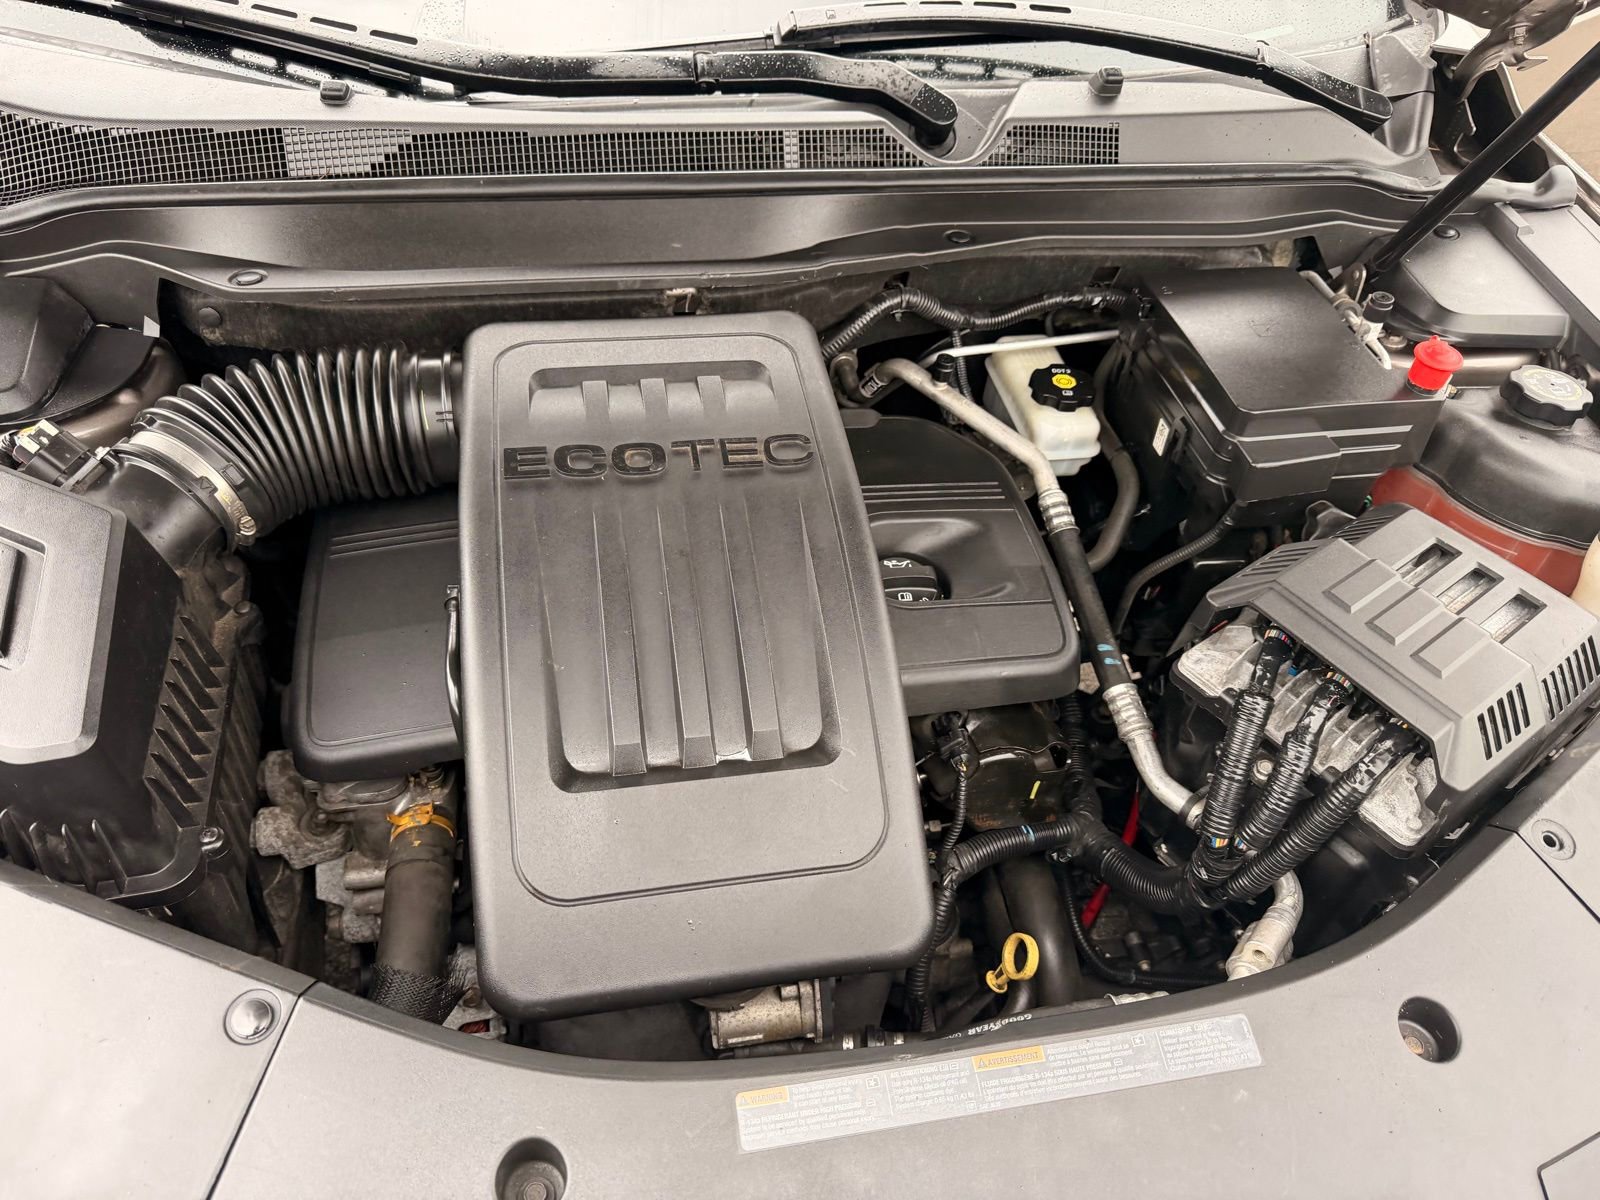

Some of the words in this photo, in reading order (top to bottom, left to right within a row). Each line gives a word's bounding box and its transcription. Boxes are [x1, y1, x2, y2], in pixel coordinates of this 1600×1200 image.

[503, 433, 814, 480] ECOTEC
[968, 1013, 1033, 1035] GOODYEAR
[988, 1051, 1038, 1066] AVERTISSEMENT
[751, 1092, 784, 1105] WARNING
